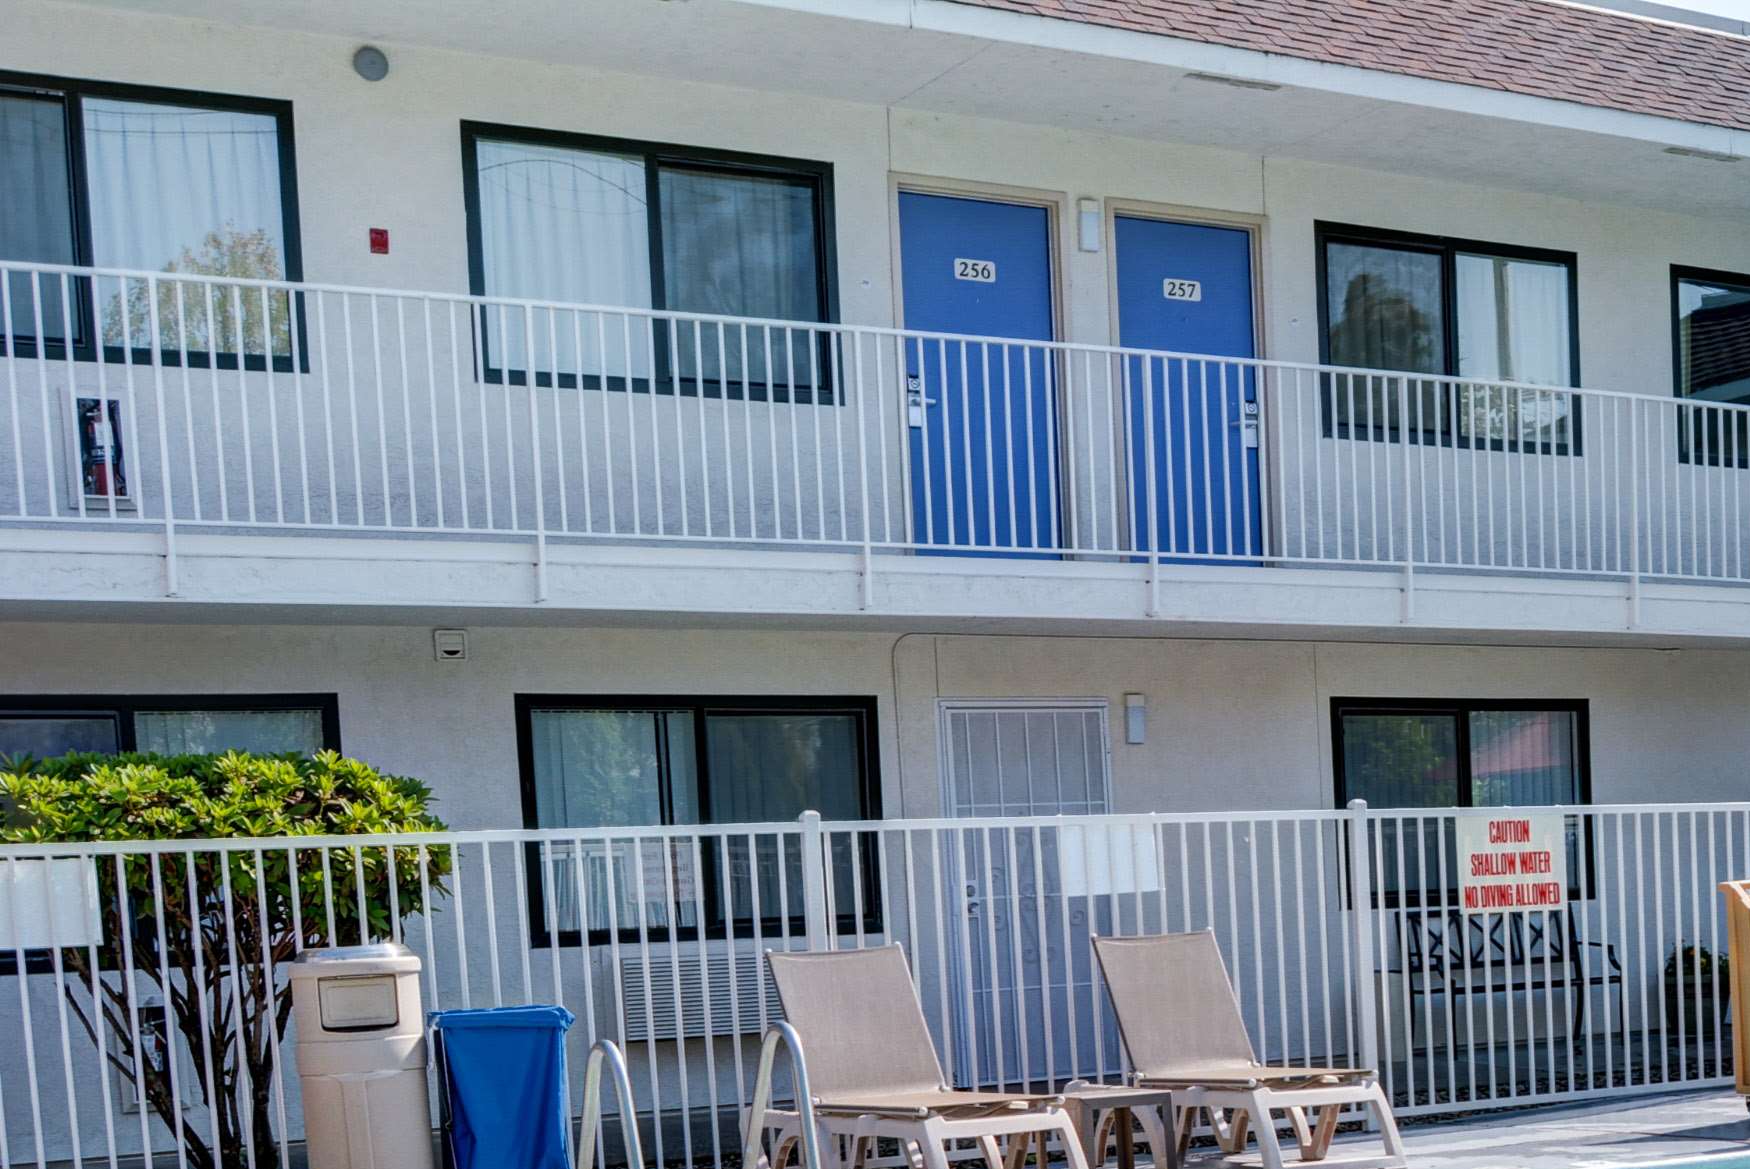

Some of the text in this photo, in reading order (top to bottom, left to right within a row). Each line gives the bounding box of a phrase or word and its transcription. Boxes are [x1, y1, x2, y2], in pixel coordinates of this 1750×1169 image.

[959, 261, 991, 279] 256
[1167, 281, 1196, 298] 257
[1489, 820, 1530, 843] CAUTION
[1471, 850, 1551, 876] SHALLOW WATER
[1464, 882, 1561, 908] NO DIVING ALLOWED
